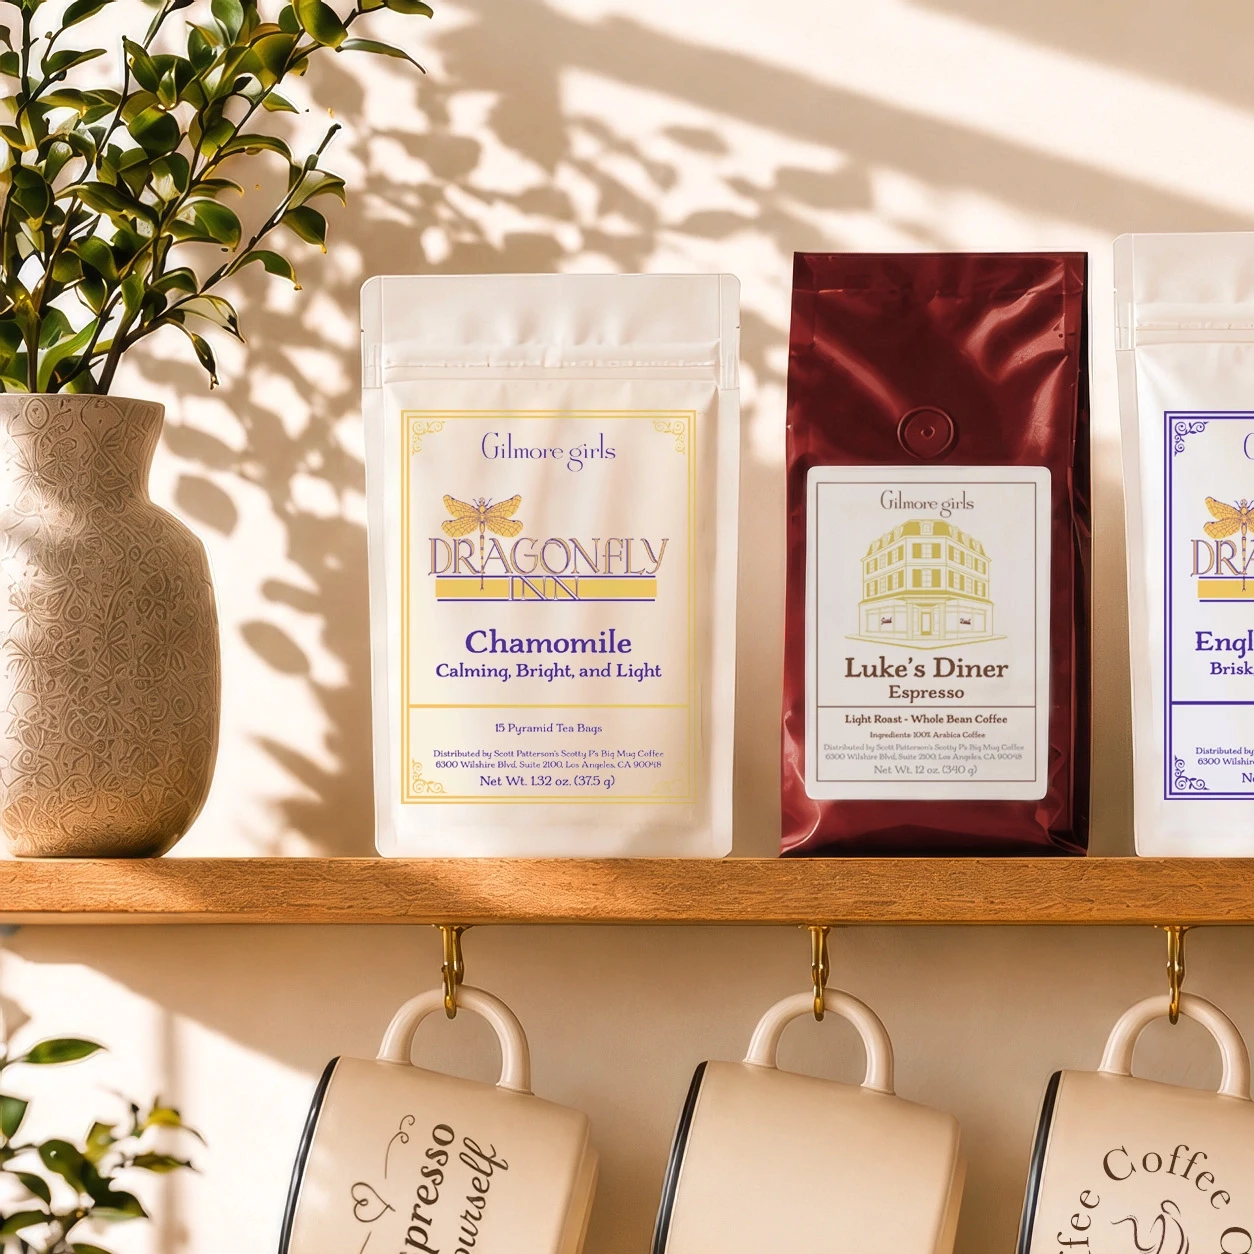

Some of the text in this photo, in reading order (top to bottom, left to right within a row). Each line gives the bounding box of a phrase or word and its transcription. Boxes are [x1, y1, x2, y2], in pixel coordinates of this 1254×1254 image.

[482, 433, 615, 471] Gilmore girls
[881, 490, 974, 518] Gilmore girls
[428, 538, 669, 576] DRAGONFLY
[507, 576, 581, 600] INN
[466, 629, 631, 653] Chamomile
[436, 663, 661, 682] Calming, Bright, and Light
[845, 656, 1008, 677] Luke's Diner
[889, 685, 964, 703] Espresso
[845, 714, 1007, 726] Light Roast Whole Bean Coffee
[1102, 1144, 1231, 1210] Coffee
